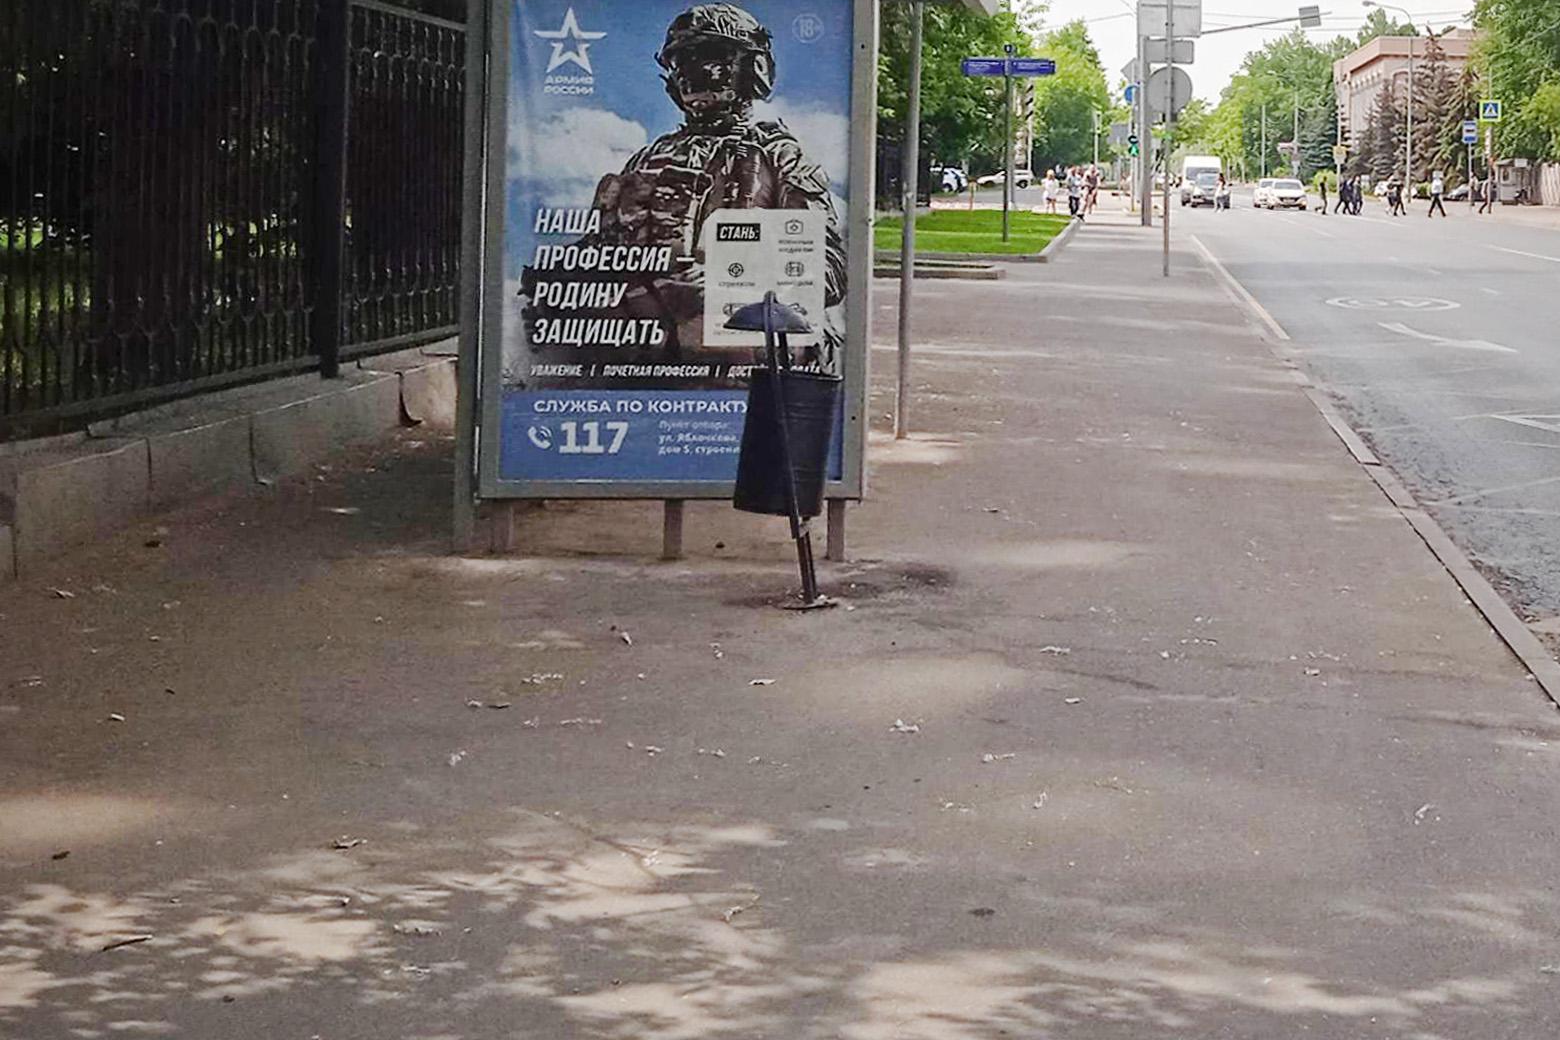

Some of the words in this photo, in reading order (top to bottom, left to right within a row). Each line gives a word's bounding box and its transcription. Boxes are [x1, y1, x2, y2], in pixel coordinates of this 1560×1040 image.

[544, 85, 594, 96] РОССИИ
[534, 209, 600, 234] НАША
[719, 225, 760, 240] СТАНЬ:
[534, 245, 673, 272] ПРОФЕССИЯ
[532, 281, 628, 311] РОДИНУ
[532, 318, 665, 348] ЗАЩИЩАТЬ
[652, 365, 710, 378] ПРОФЕССИЯ
[533, 399, 612, 413] СЛУЖБА
[616, 399, 643, 413] ПО
[647, 400, 748, 414] КОНТРАКТУ
[558, 421, 629, 455] 117
